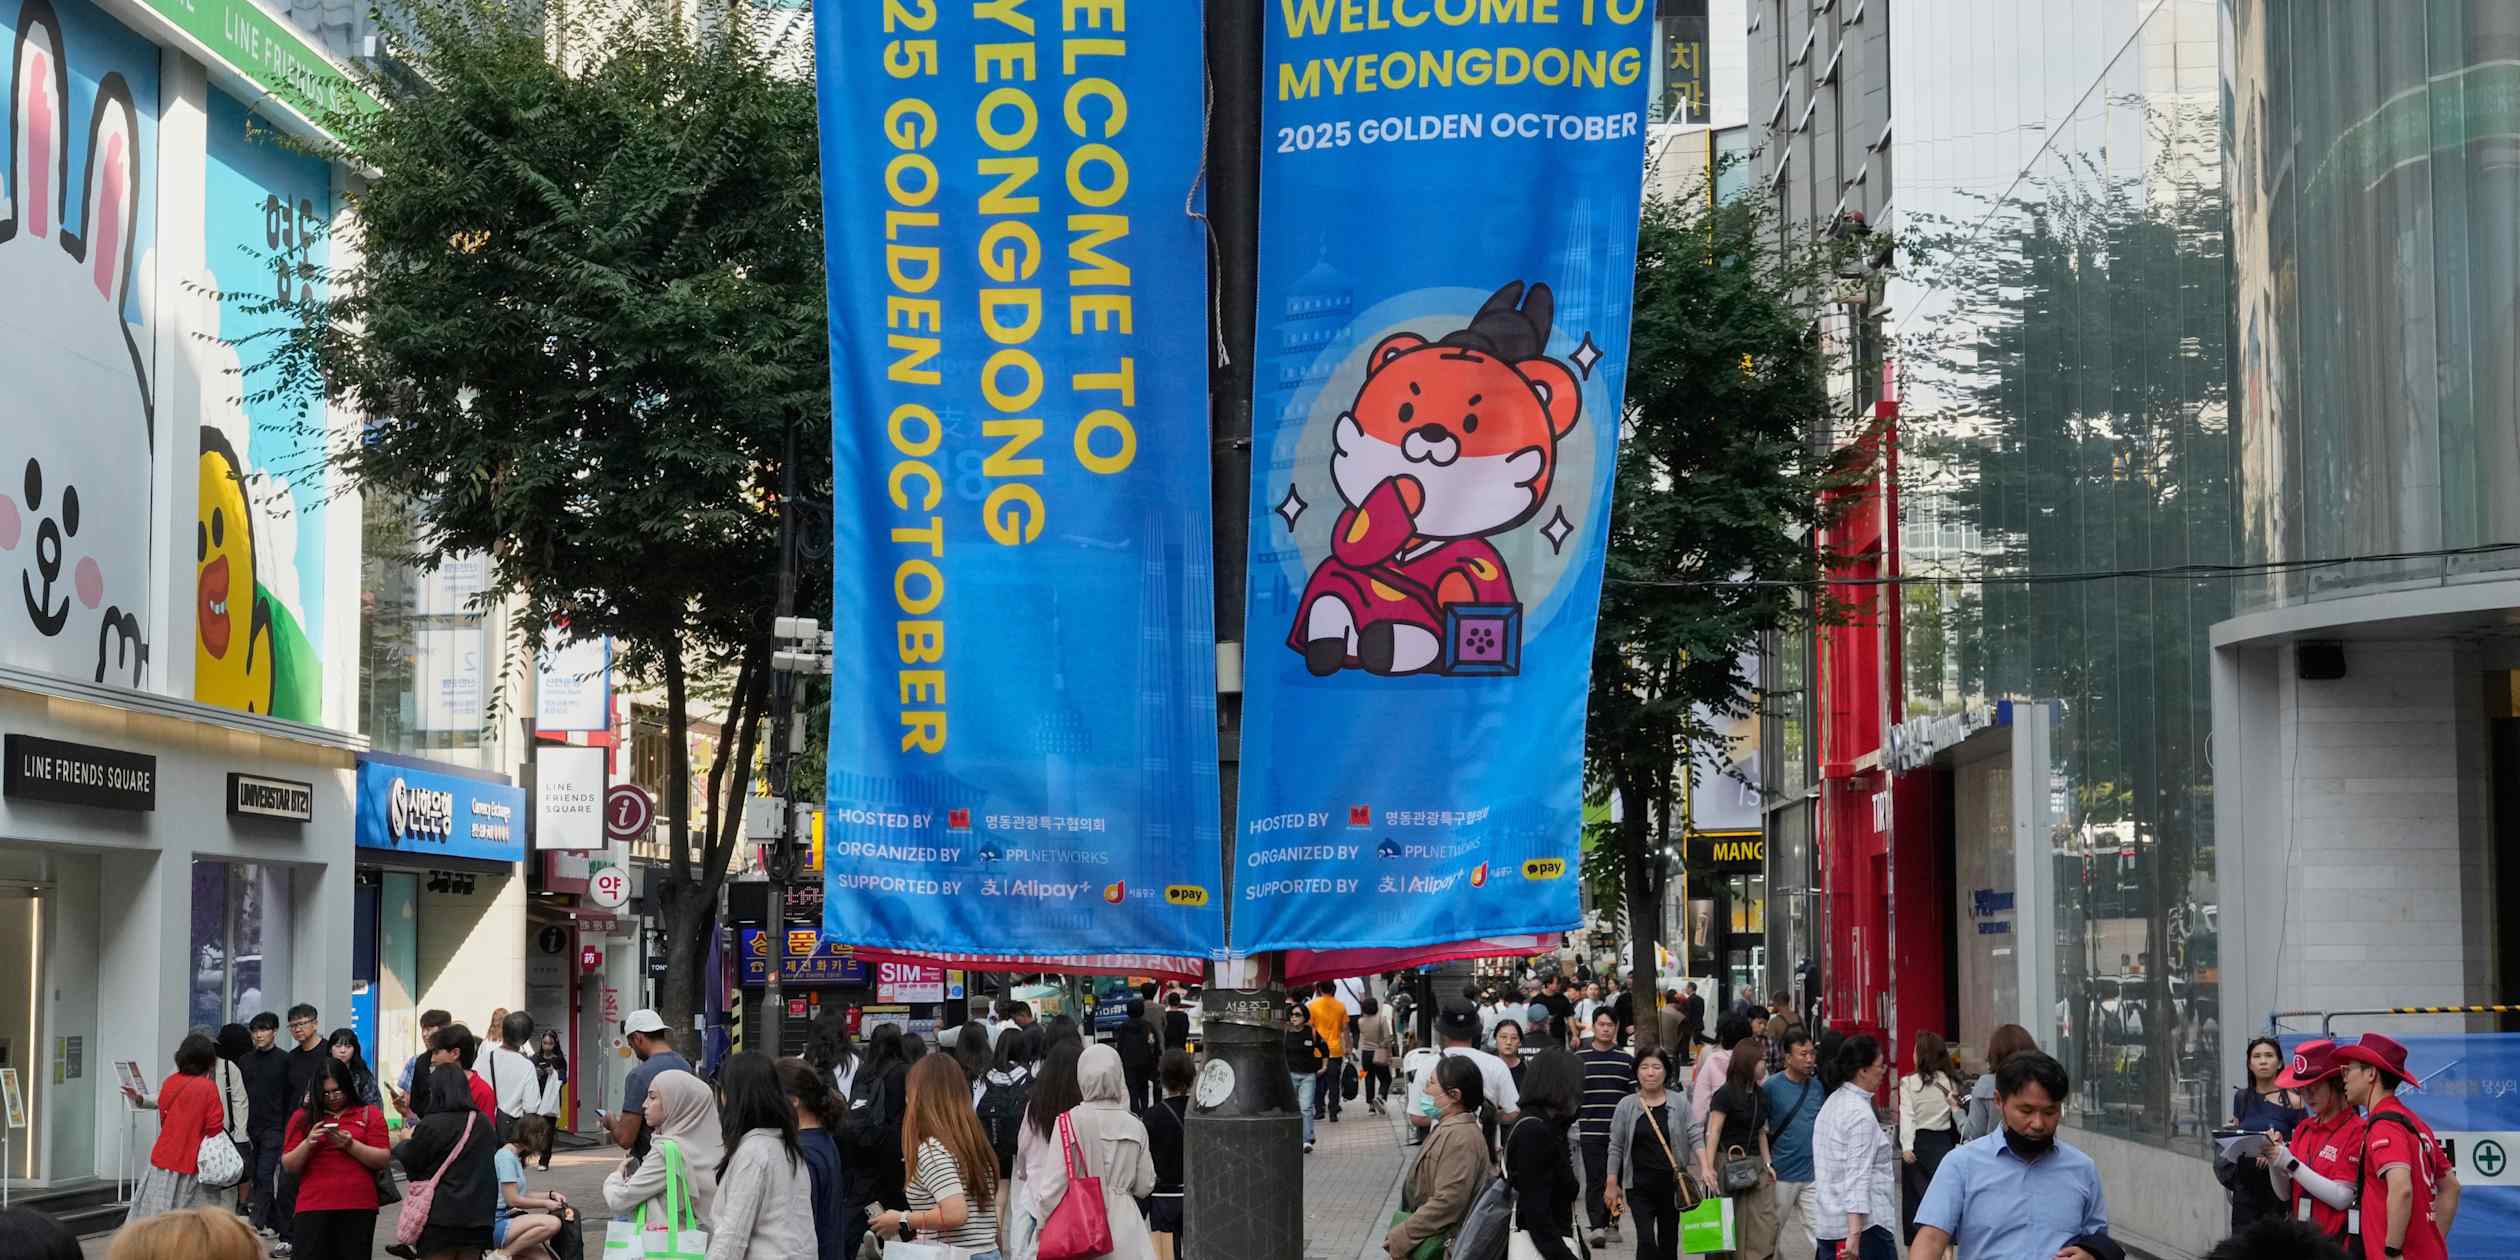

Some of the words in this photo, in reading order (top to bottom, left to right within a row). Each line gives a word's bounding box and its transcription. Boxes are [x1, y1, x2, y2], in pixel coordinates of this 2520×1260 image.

[1280, 0, 1559, 39] WELCOME
[1582, 0, 1645, 26] TO
[224, 5, 259, 60] LINE
[1277, 47, 1642, 101] MYEONGDONG
[1276, 121, 1352, 154] 2025
[1358, 112, 1483, 144] GOLDEN
[1490, 111, 1638, 142] OCTOBER
[883, 97, 942, 385] GOLDEN
[1072, 357, 1137, 475] TO
[887, 403, 948, 755] OCTOBER
[24, 753, 52, 780] LINE
[55, 758, 104, 787] FRIENDS
[107, 766, 151, 793] SQUARE
[545, 783, 574, 791] LINE
[545, 793, 596, 802] FRIENDS
[290, 788, 310, 814] BT21
[408, 788, 453, 836] 신한은행
[545, 805, 593, 814] SQUARE
[839, 808, 909, 829] HOSTED
[913, 814, 932, 829] BY
[985, 815, 1105, 832] 명동관광특구협의회
[1249, 814, 1304, 834] HOSTED
[1308, 812, 1329, 828] BY
[838, 841, 937, 862] ORGANIZED
[940, 847, 960, 863] BY
[1006, 848, 1109, 864] PPLNETWORKS
[1247, 845, 1334, 867] ORGANIZED
[1337, 845, 1359, 860] BY
[1540, 863, 1561, 876] pay
[598, 876, 622, 900] 약
[838, 873, 938, 895] SUPPORTED
[942, 880, 962, 896] BY
[1181, 889, 1202, 902] pay
[1245, 878, 1332, 900] SUPPORTED
[1337, 879, 1359, 893] BY
[881, 962, 920, 982] SIM
[1225, 1000, 1270, 1012] 서울중구
